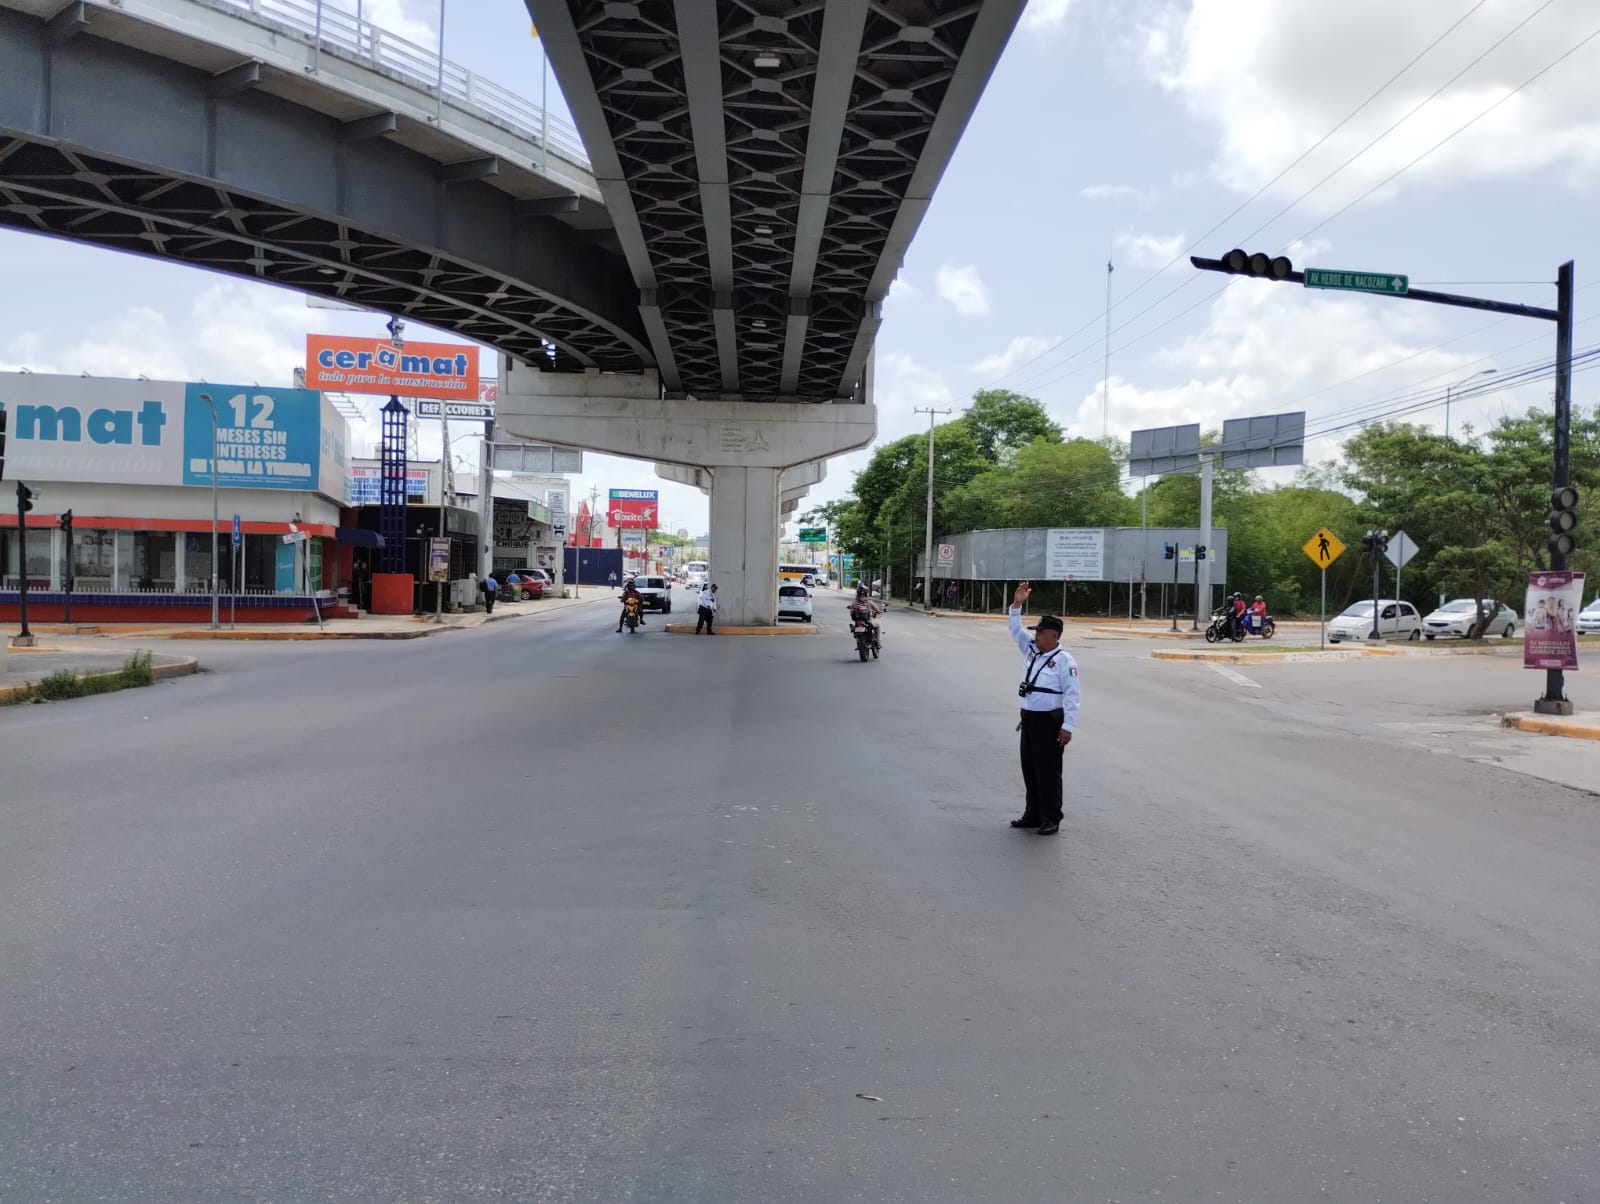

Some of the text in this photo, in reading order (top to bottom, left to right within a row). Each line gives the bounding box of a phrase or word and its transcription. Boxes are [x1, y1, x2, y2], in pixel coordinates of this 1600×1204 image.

[1344, 275, 1352, 286] DE
[1355, 275, 1387, 289] NACOZARI
[318, 347, 468, 377] ceramat
[319, 370, 345, 382] todo
[347, 373, 376, 385] para
[378, 374, 390, 385] la
[228, 394, 275, 429] 12
[421, 402, 486, 416] REFCCIONES
[216, 428, 287, 445] MESES SIN
[216, 443, 287, 460] INTERESES
[618, 491, 656, 499] BENELUX
[614, 513, 643, 521] Boxito
